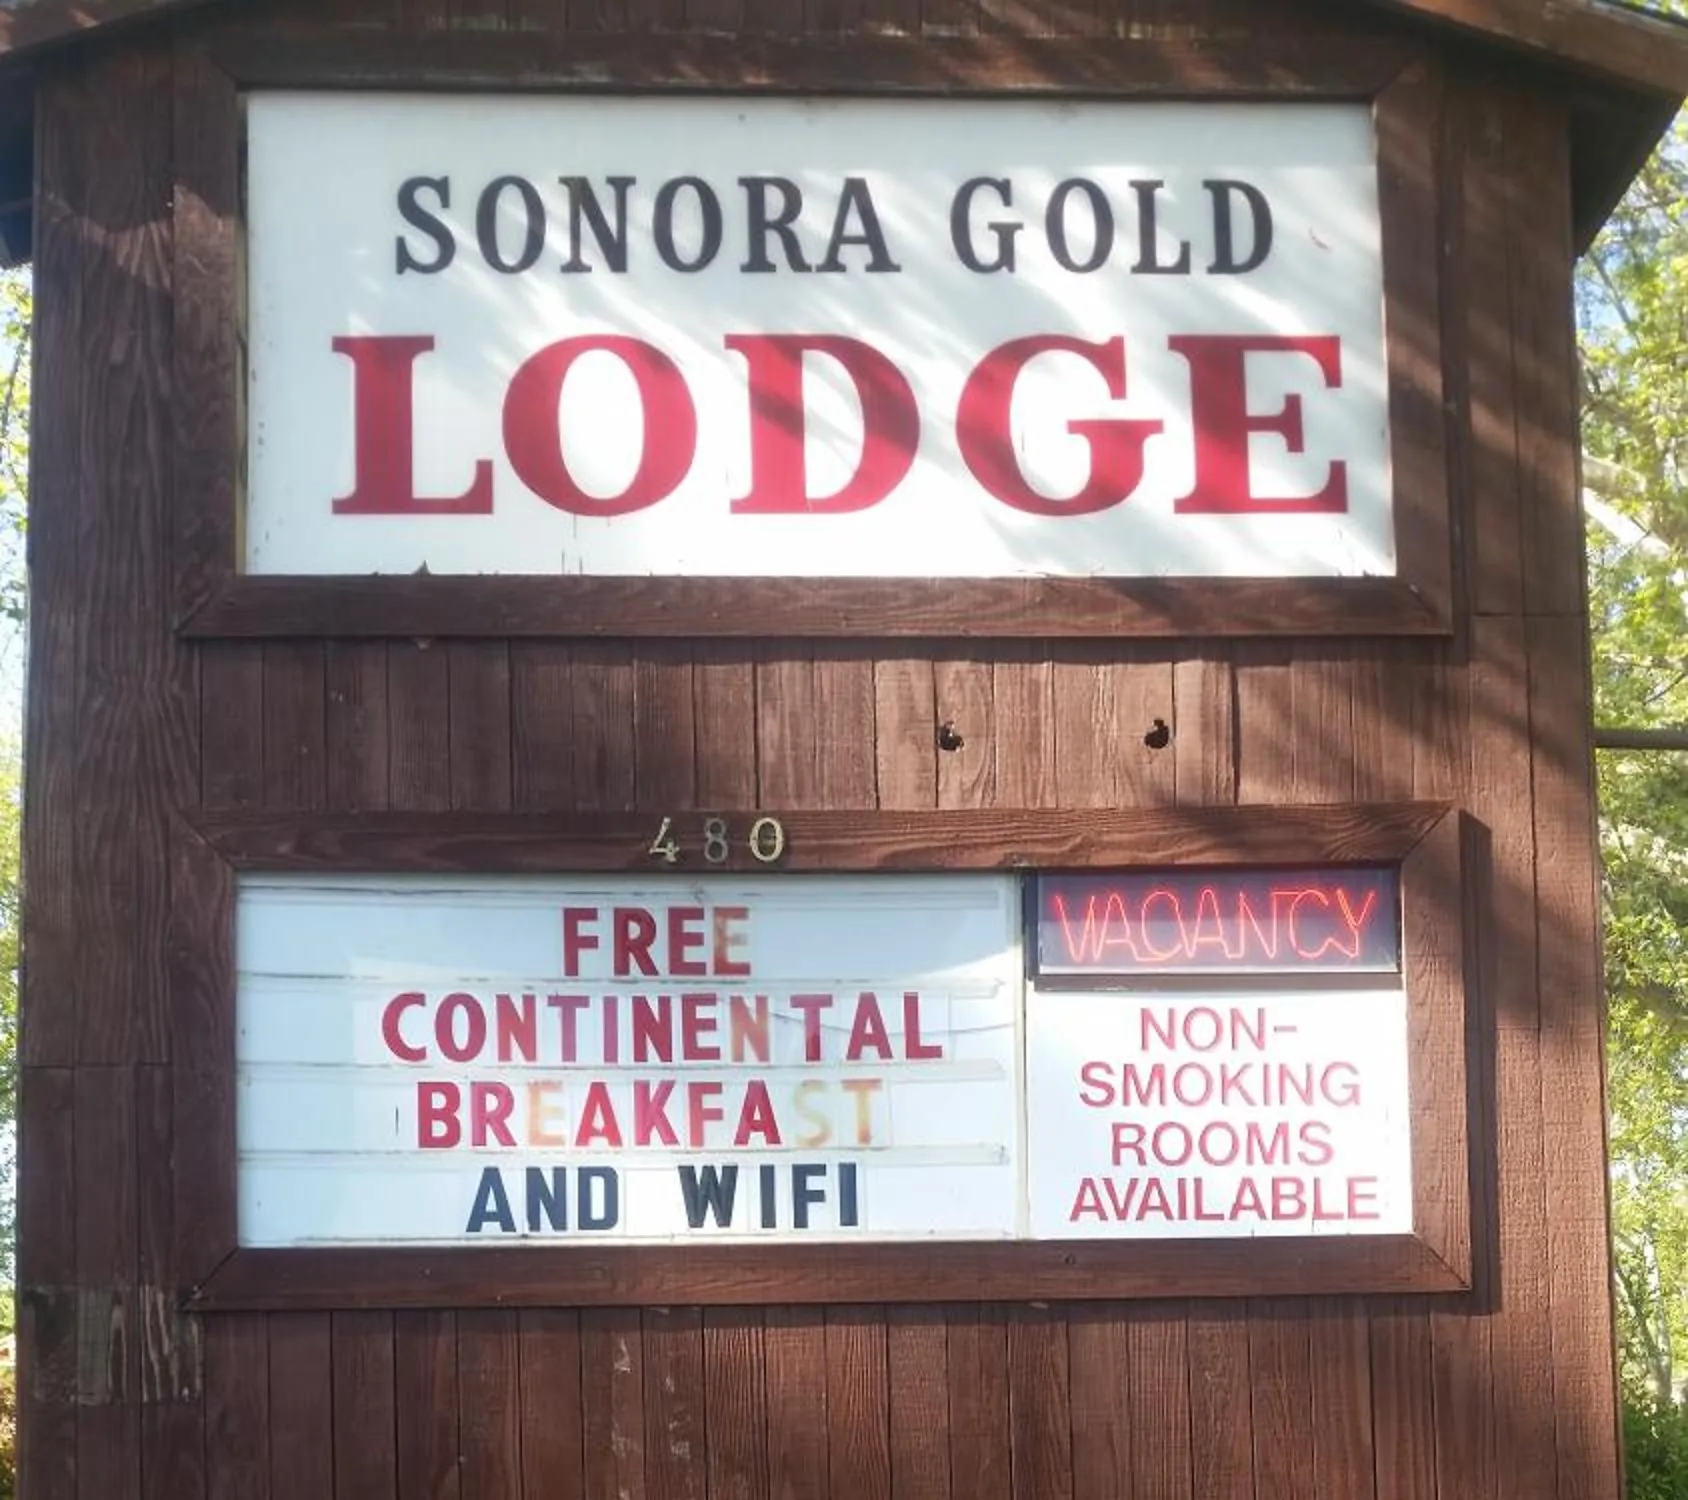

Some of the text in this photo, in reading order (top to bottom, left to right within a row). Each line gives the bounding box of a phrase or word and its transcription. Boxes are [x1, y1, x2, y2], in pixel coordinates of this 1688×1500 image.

[395, 174, 1274, 275] SONORA GOLD
[331, 333, 1348, 516] LODGE
[649, 816, 785, 863] 480
[562, 906, 751, 976] FREE
[1053, 888, 1375, 961] VACANCY
[382, 992, 943, 1063] CONTINENTAL
[1140, 1007, 1297, 1051] NON-
[416, 1078, 883, 1149] BREAKFAST
[1079, 1061, 1361, 1107] SMOKING
[1112, 1120, 1334, 1166] ROOMS
[466, 1162, 859, 1232] AND WIFI
[1070, 1176, 1380, 1222] AVAILABLE
